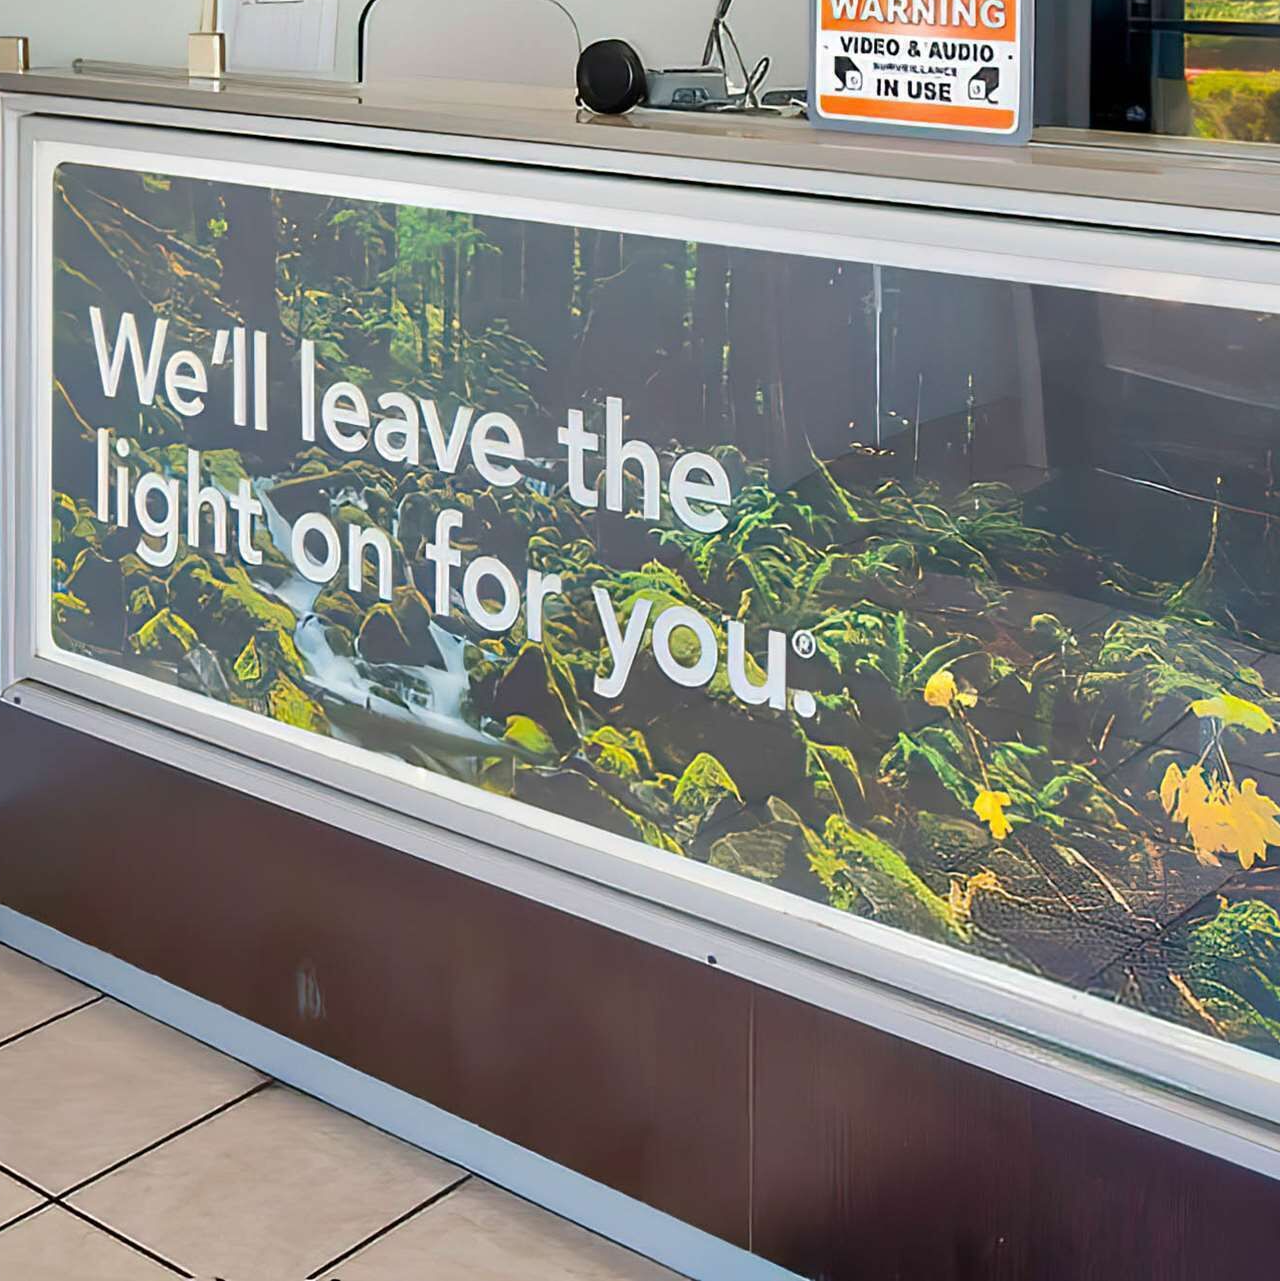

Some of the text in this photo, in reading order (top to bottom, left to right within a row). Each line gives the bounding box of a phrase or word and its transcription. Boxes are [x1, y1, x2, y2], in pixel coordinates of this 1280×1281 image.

[840, 35, 994, 63] VIDEO & AUDIO
[876, 78, 953, 103] IN USE
[88, 305, 733, 535] We'll leave the
[96, 427, 264, 569] light
[290, 510, 395, 602] on
[424, 507, 563, 643] for
